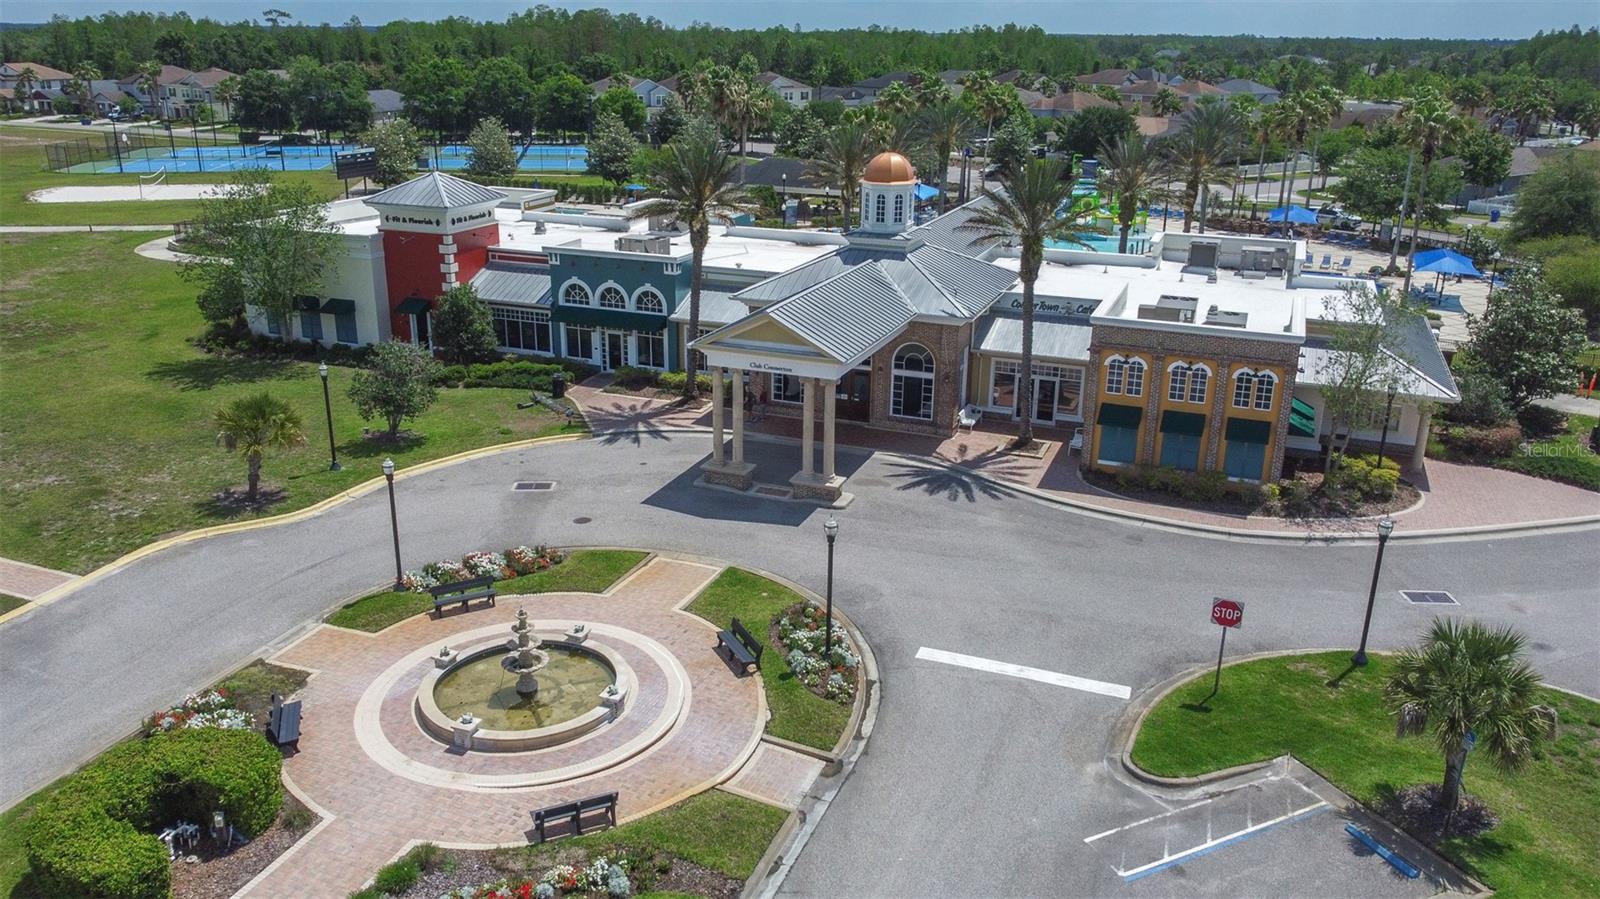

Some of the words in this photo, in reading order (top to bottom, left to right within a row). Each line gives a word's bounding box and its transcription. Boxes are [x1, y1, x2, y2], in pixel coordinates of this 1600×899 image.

[408, 217, 433, 225] Flourish
[468, 212, 487, 221] Flourish
[1011, 299, 1039, 310] Cor
[1040, 300, 1060, 312] Town
[749, 361, 762, 369] Club
[1213, 606, 1241, 620] STOP
